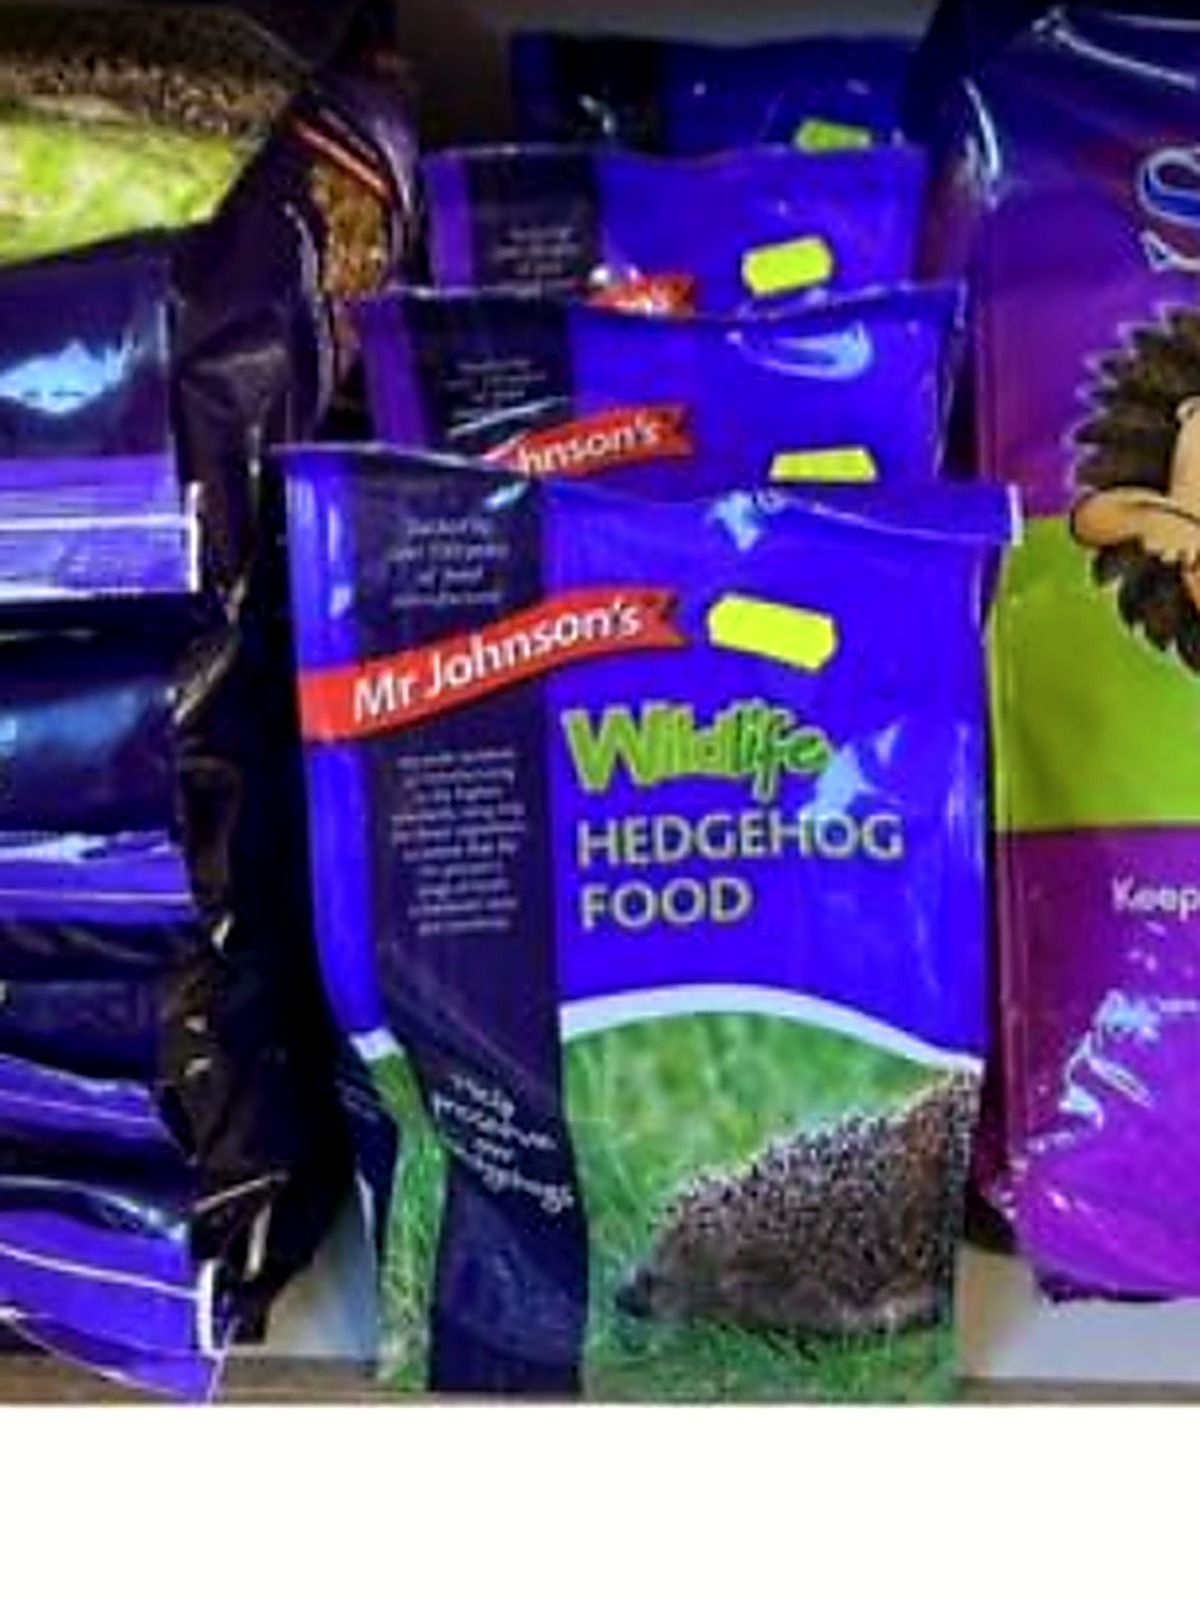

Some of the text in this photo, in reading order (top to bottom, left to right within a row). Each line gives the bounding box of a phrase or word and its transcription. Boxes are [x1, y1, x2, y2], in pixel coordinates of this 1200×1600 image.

[519, 416, 659, 475] hnson's
[354, 595, 642, 722] Mr Johnson's
[561, 698, 834, 801] Wildlife
[576, 808, 904, 869] HEDGEHOG
[580, 875, 753, 930] FOOD
